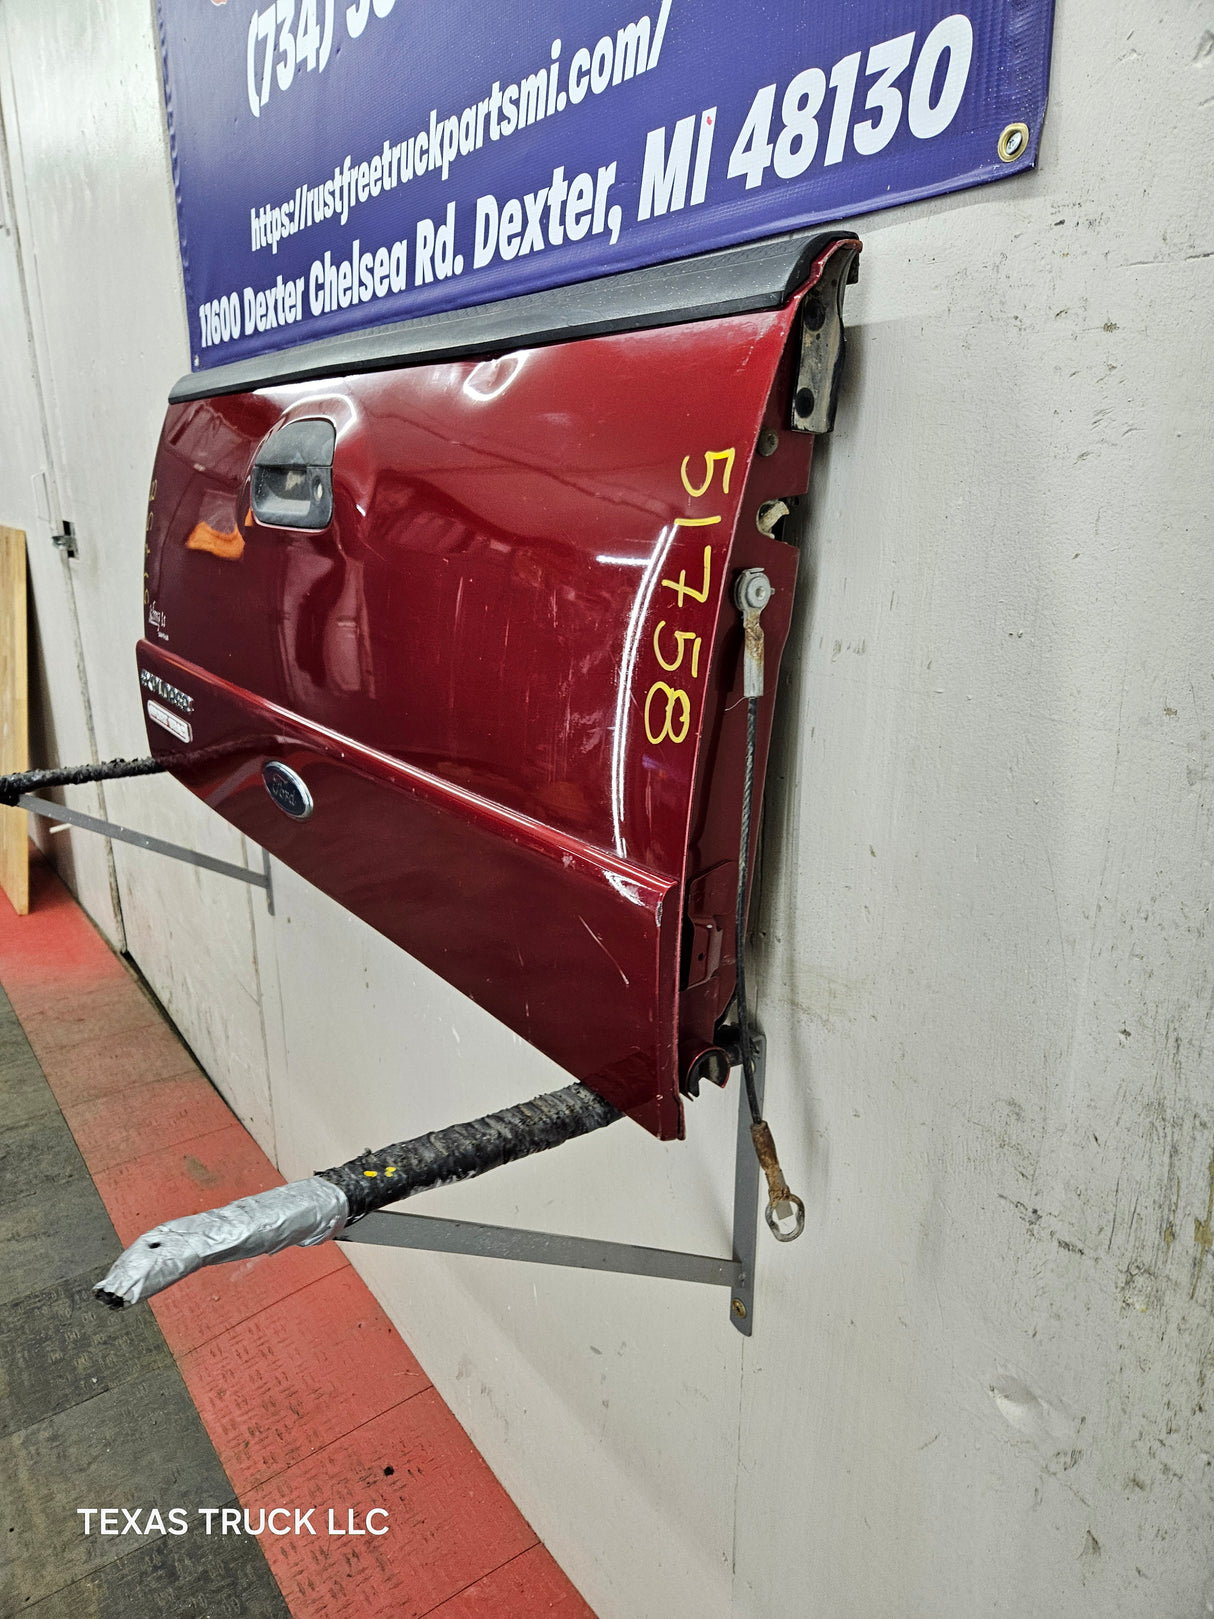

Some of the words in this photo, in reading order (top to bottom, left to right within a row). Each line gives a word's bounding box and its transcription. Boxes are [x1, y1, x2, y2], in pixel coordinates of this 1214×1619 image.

[199, 292, 241, 348] 11600
[244, 275, 304, 335] Dexter
[309, 239, 408, 316] Chelsea
[414, 201, 464, 286] Rd.
[473, 160, 622, 270] Dexter,
[637, 106, 717, 221] MI
[727, 14, 973, 190] 48130
[247, 0, 334, 118] (734)
[251, 0, 672, 254] https://rustfreetruckpartsmi.com/
[644, 447, 735, 744] 51758
